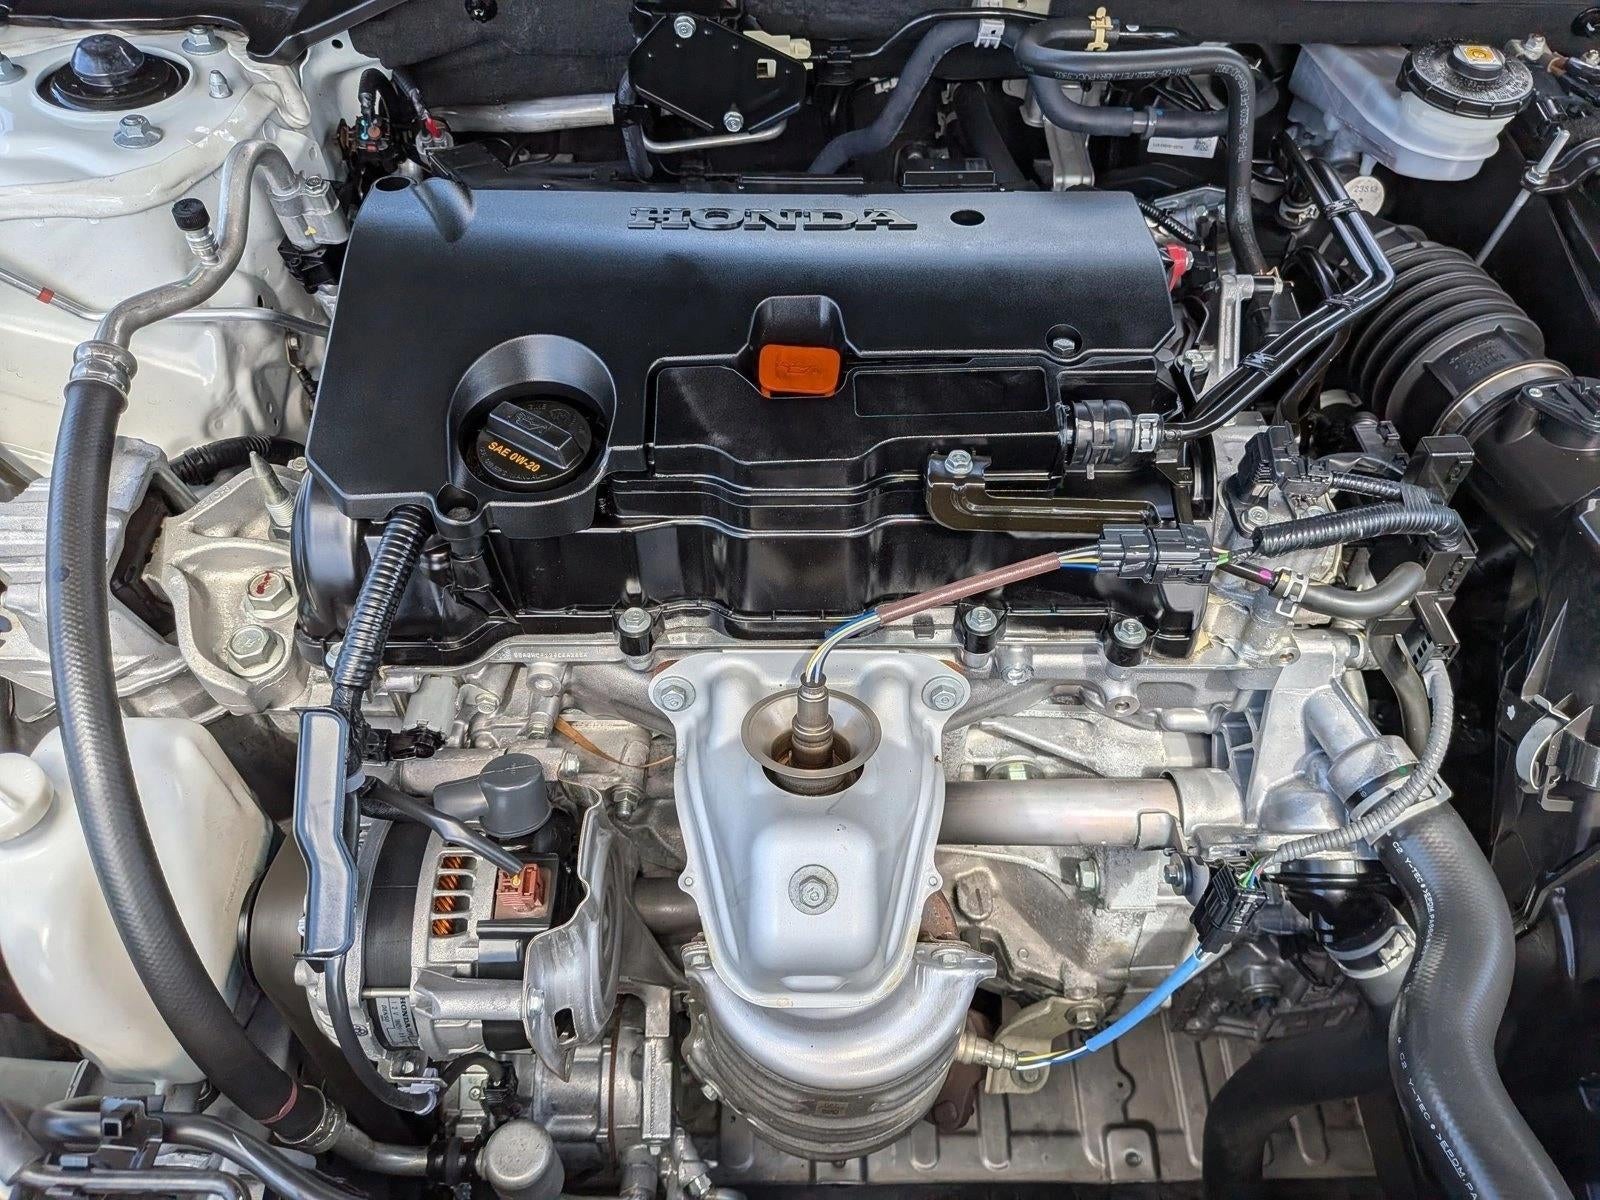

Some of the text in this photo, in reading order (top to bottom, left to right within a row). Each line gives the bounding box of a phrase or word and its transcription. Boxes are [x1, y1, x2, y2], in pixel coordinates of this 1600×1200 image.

[627, 206, 918, 231] HONDA
[488, 441, 511, 457] SAE
[509, 452, 541, 472] 0W-20
[1392, 841, 1403, 854] C2
[1405, 857, 1423, 884] Y-TEC
[1399, 1052, 1407, 1069] C2
[1408, 1078, 1431, 1120] Y-TEC
